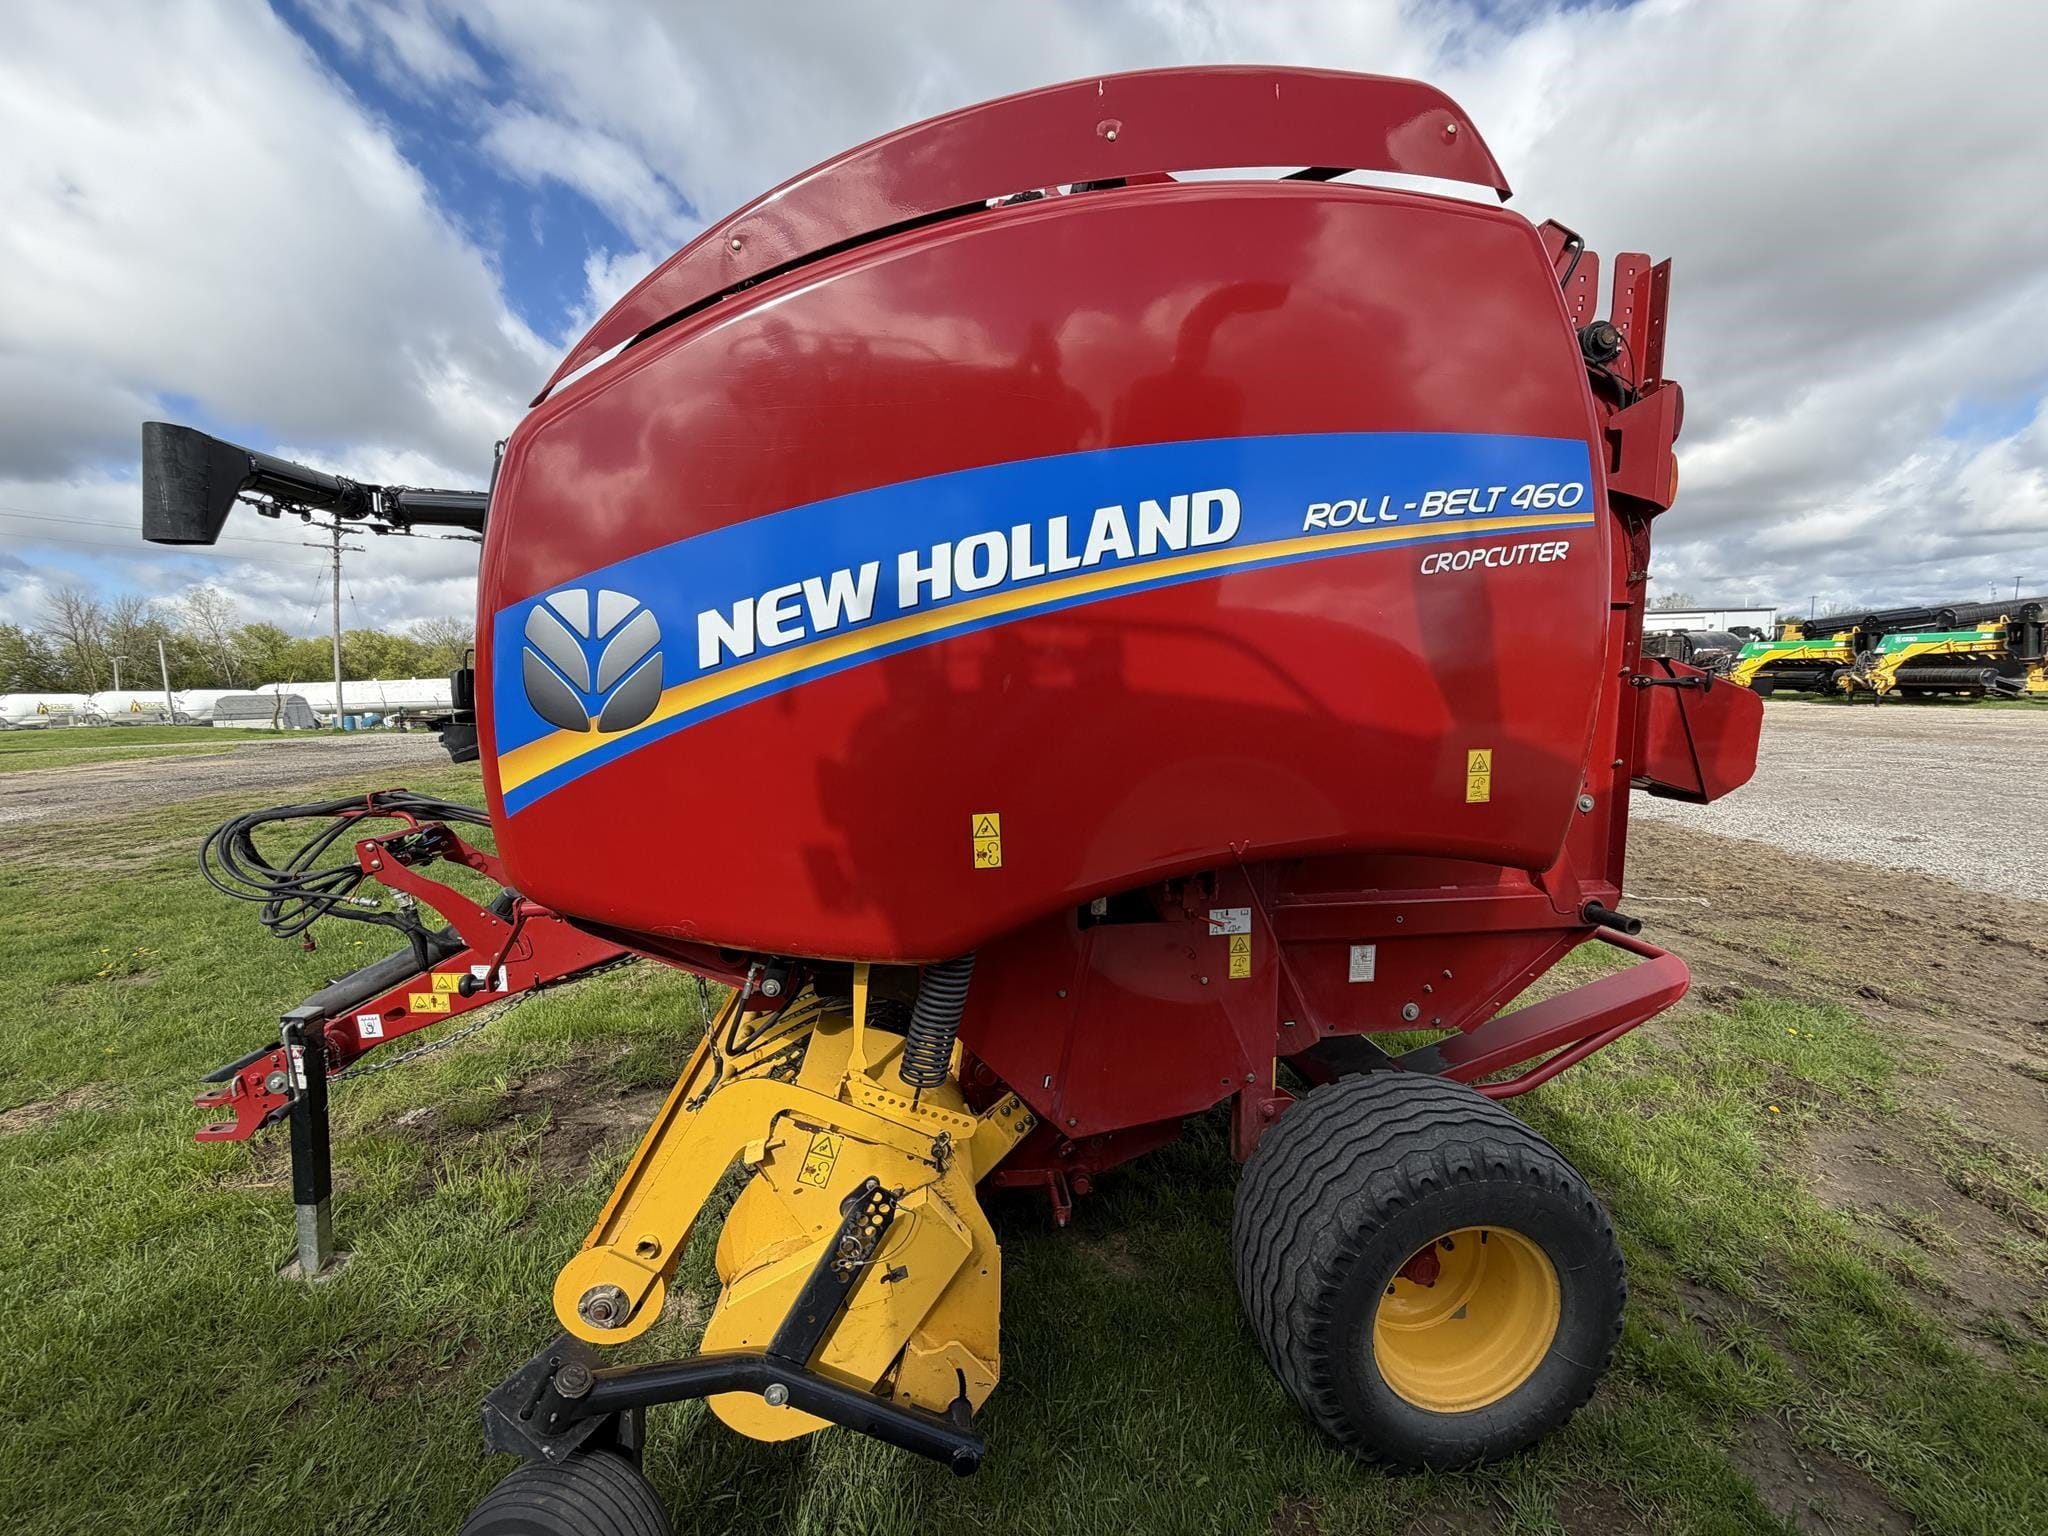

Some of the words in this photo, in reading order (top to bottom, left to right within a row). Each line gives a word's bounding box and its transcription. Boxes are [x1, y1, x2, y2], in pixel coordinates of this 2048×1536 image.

[1510, 482, 1584, 511] 460
[1420, 541, 1570, 575] CROPCUTTER
[697, 561, 880, 670] NEW
[898, 488, 1241, 610] HOLLAND
